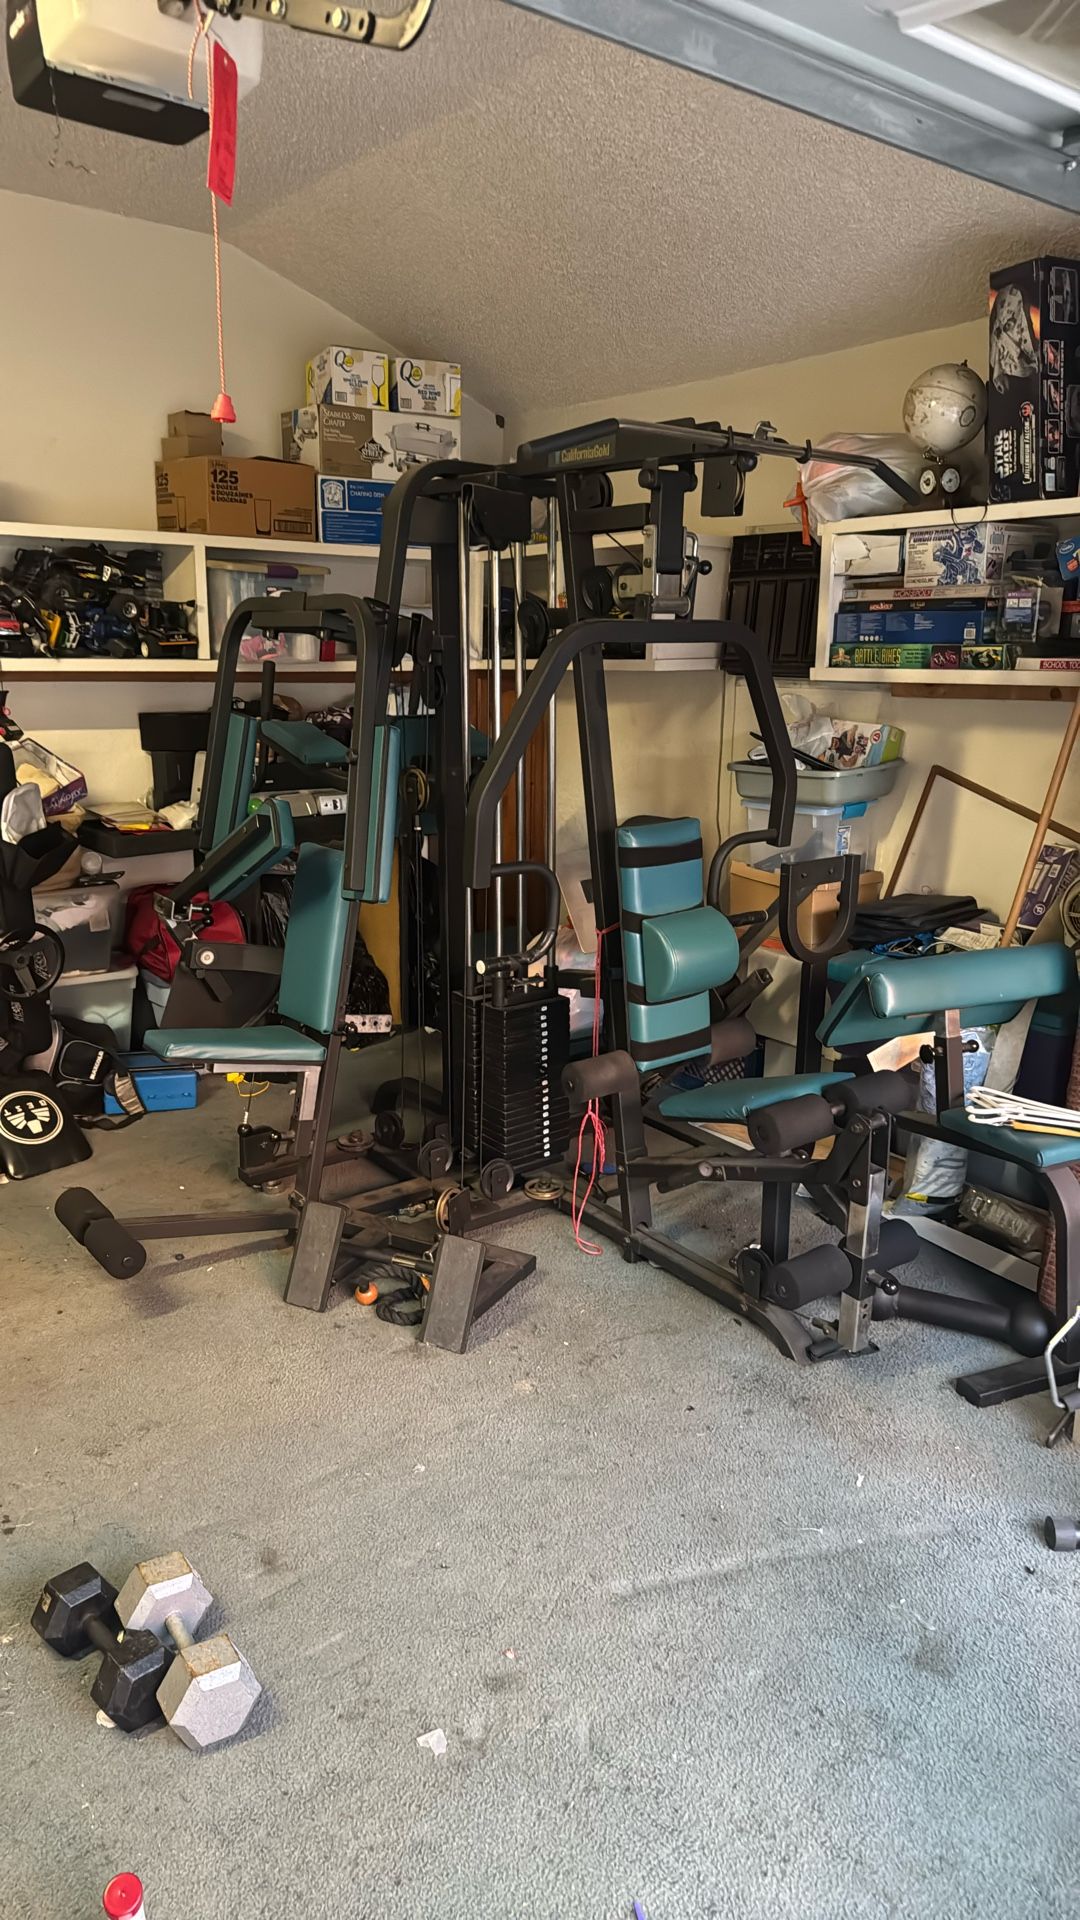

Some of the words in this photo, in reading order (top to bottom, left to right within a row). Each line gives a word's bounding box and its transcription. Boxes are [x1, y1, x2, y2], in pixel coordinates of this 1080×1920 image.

[335, 350, 352, 373] Q
[400, 360, 421, 388] Q
[561, 443, 610, 463] CaliforniaGold
[994, 429, 1004, 479] STAR
[1003, 428, 1013, 478] WARS
[211, 469, 239, 485] 125
[216, 483, 239, 491] DOZEN
[893, 589, 933, 598] MONOPOLY
[854, 648, 880, 664] BATTLE
[881, 648, 901, 664] BIKES
[1043, 661, 1067, 669] SCHOOL
